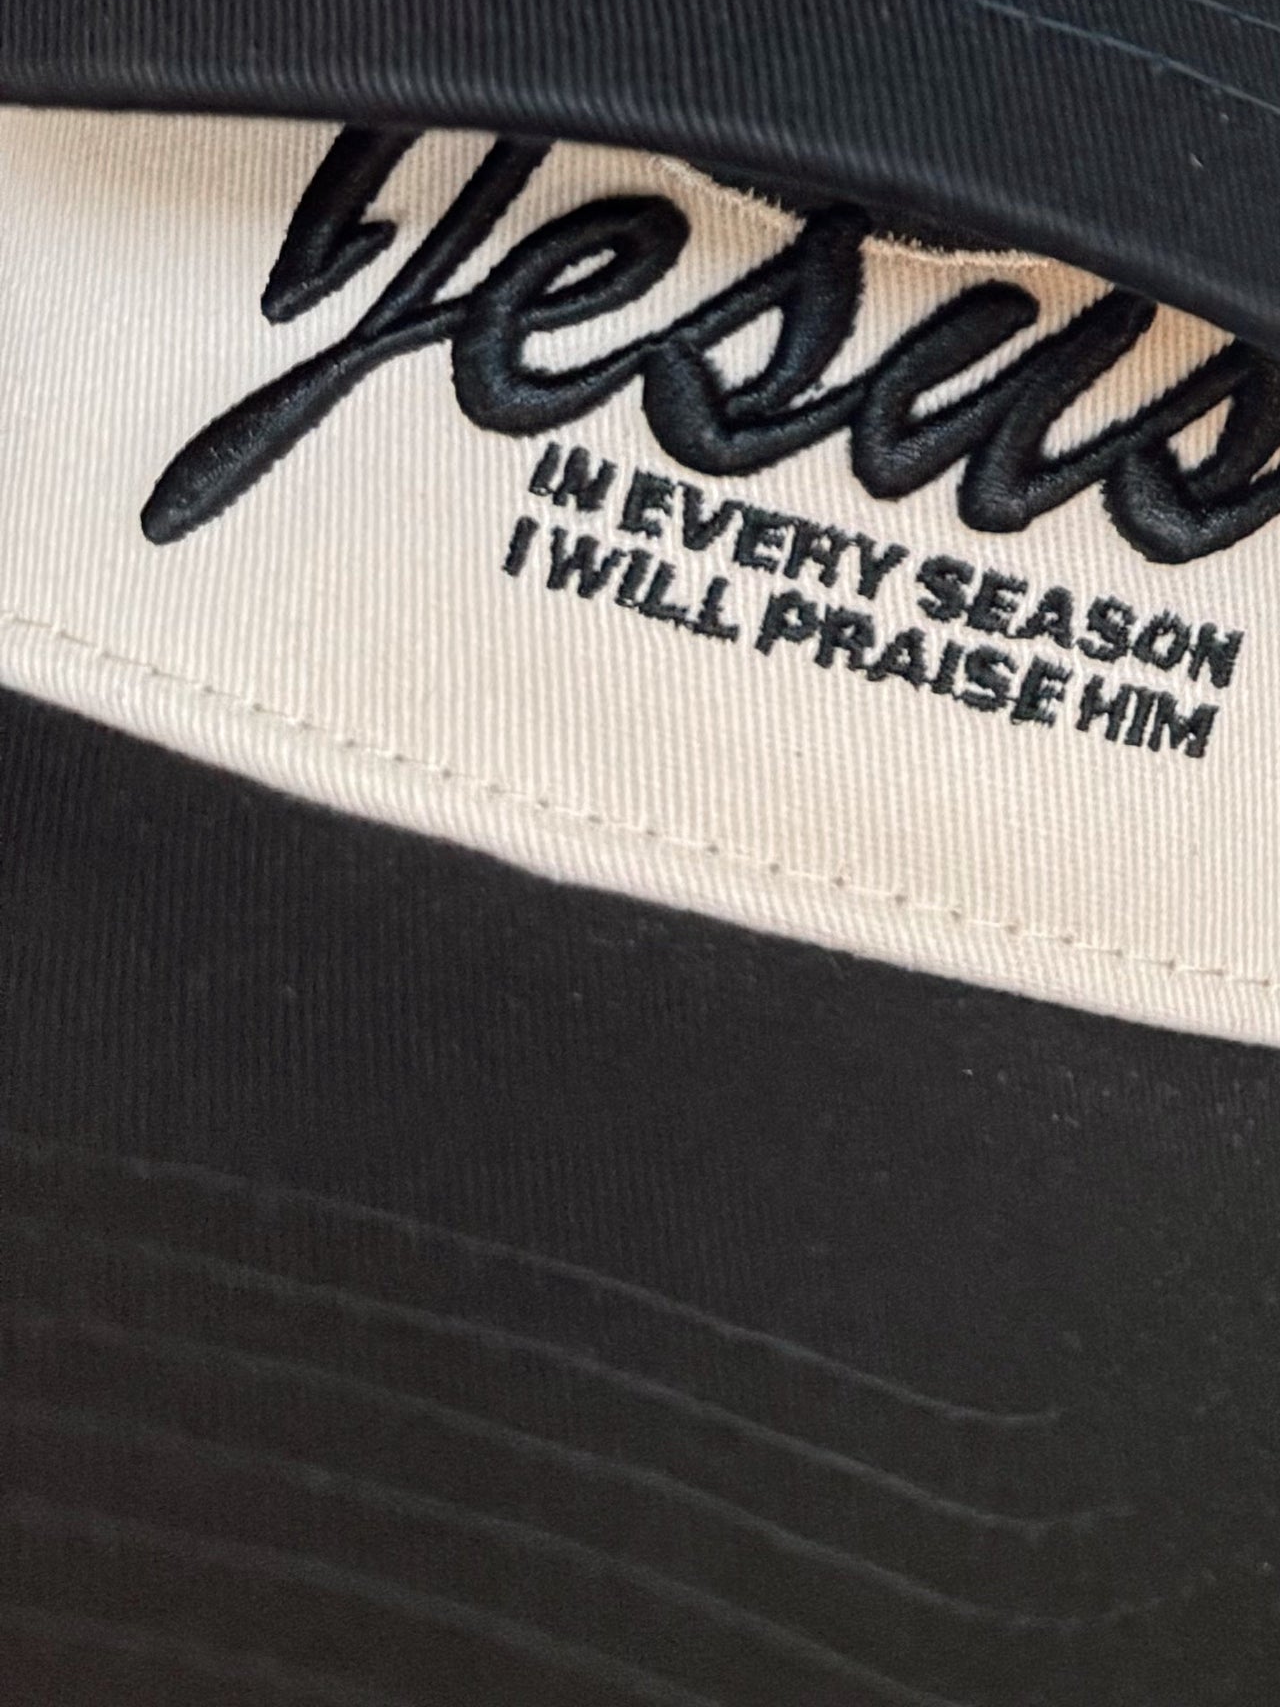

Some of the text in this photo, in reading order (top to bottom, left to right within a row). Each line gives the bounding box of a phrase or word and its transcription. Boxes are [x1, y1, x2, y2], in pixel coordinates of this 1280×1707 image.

[503, 515, 1221, 759] I WILL PRAISE HIM
[528, 442, 1245, 687] IN EVERY SEASON
